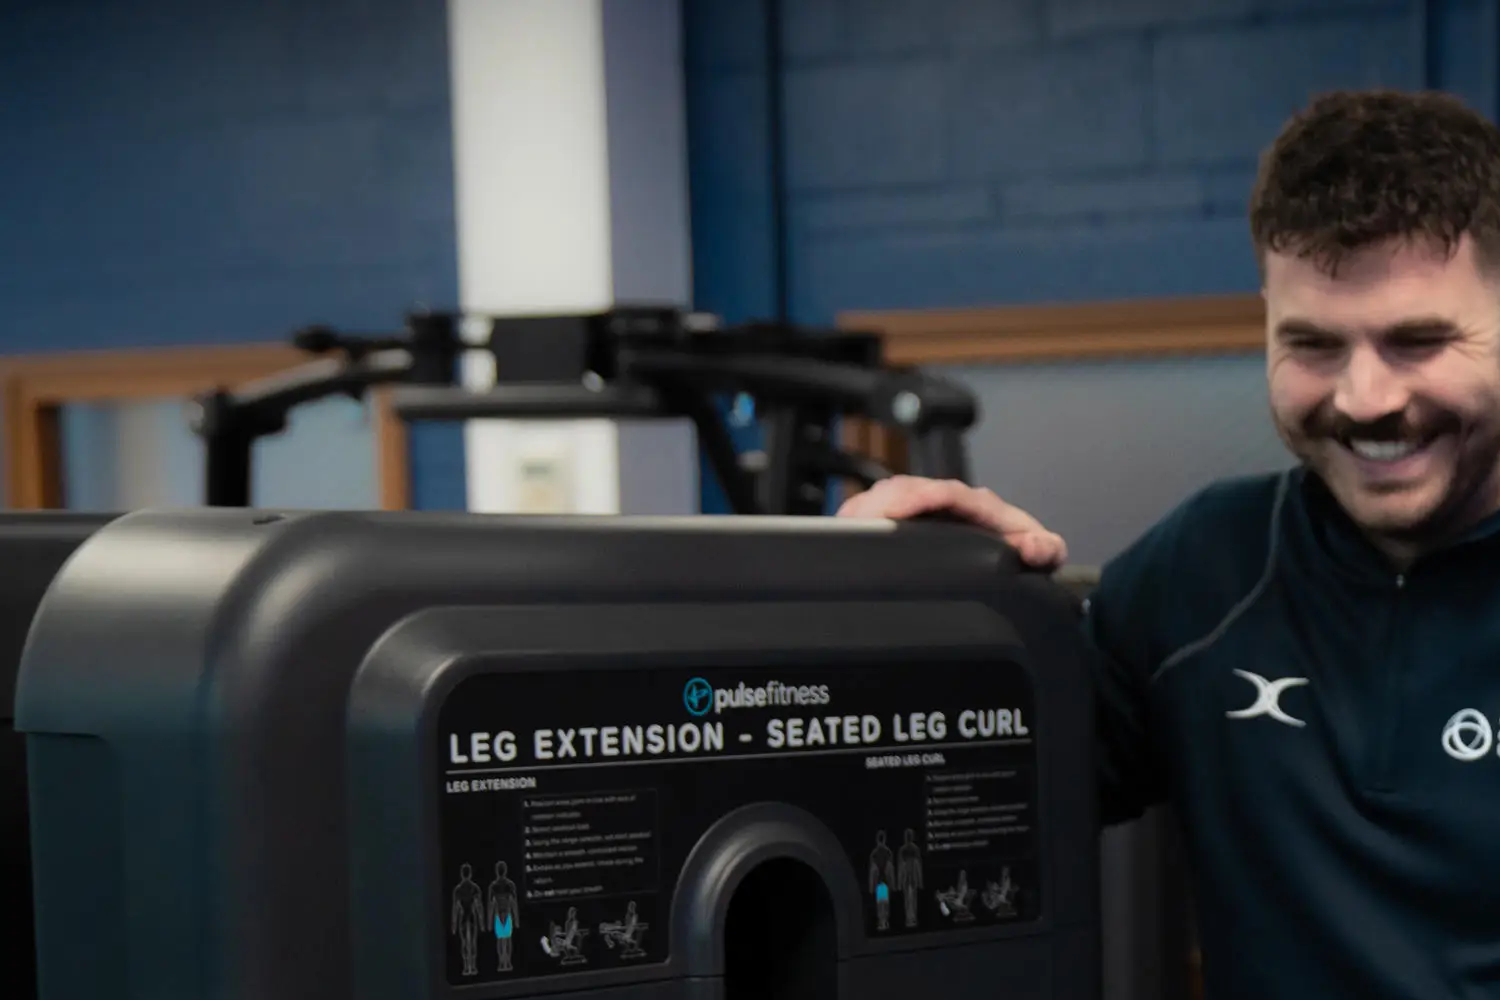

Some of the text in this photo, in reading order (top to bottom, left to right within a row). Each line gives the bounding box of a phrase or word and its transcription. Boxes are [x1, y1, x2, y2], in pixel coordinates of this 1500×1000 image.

[714, 681, 830, 714] pulsefitness
[450, 707, 1029, 764] LEG EXTENSION - SEATED LEG CURL
[865, 752, 946, 769] SEATED LEG CURL
[446, 776, 537, 793] LEG EXTENSION
